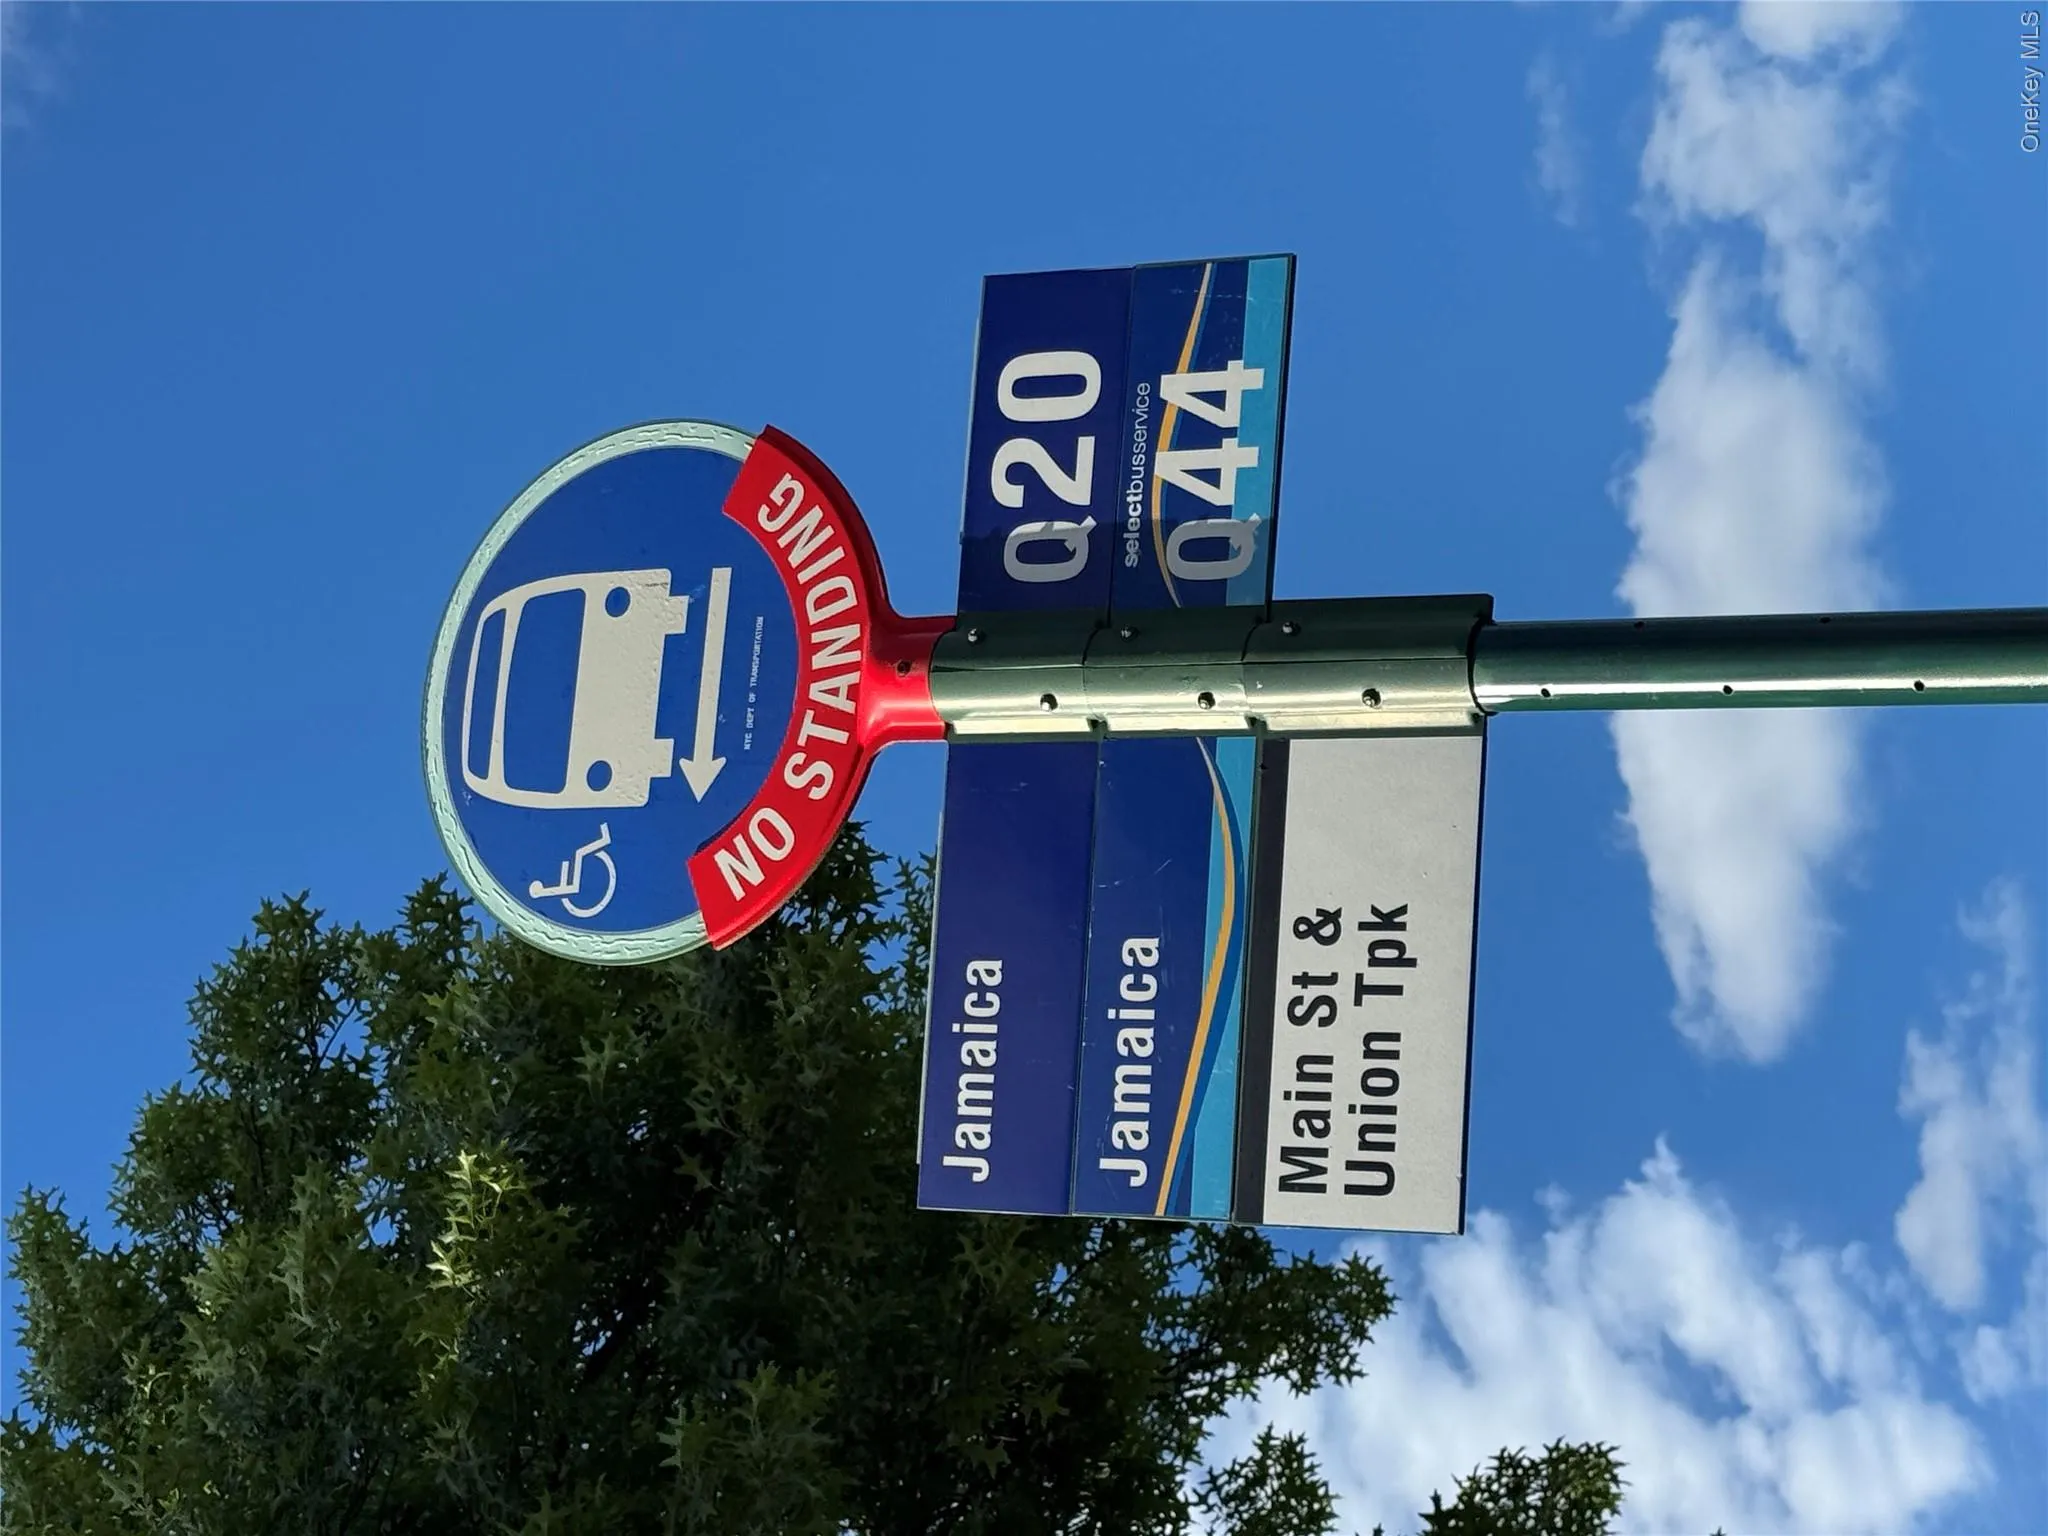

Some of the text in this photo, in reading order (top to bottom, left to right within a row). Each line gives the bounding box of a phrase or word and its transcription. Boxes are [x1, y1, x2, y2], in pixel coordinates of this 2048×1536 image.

[991, 351, 1101, 582] Q20
[1124, 382, 1151, 568] selectbusservice
[1155, 360, 1265, 582] Q44
[714, 472, 861, 901] NO STANDING
[744, 616, 764, 750] NYC DEPT OF TRANSPORTATION
[942, 959, 1003, 1183] Jamaica
[1099, 936, 1161, 1187] Jamaica
[1278, 907, 1343, 1194] Main St &
[1344, 903, 1418, 1196] Union Tpk
